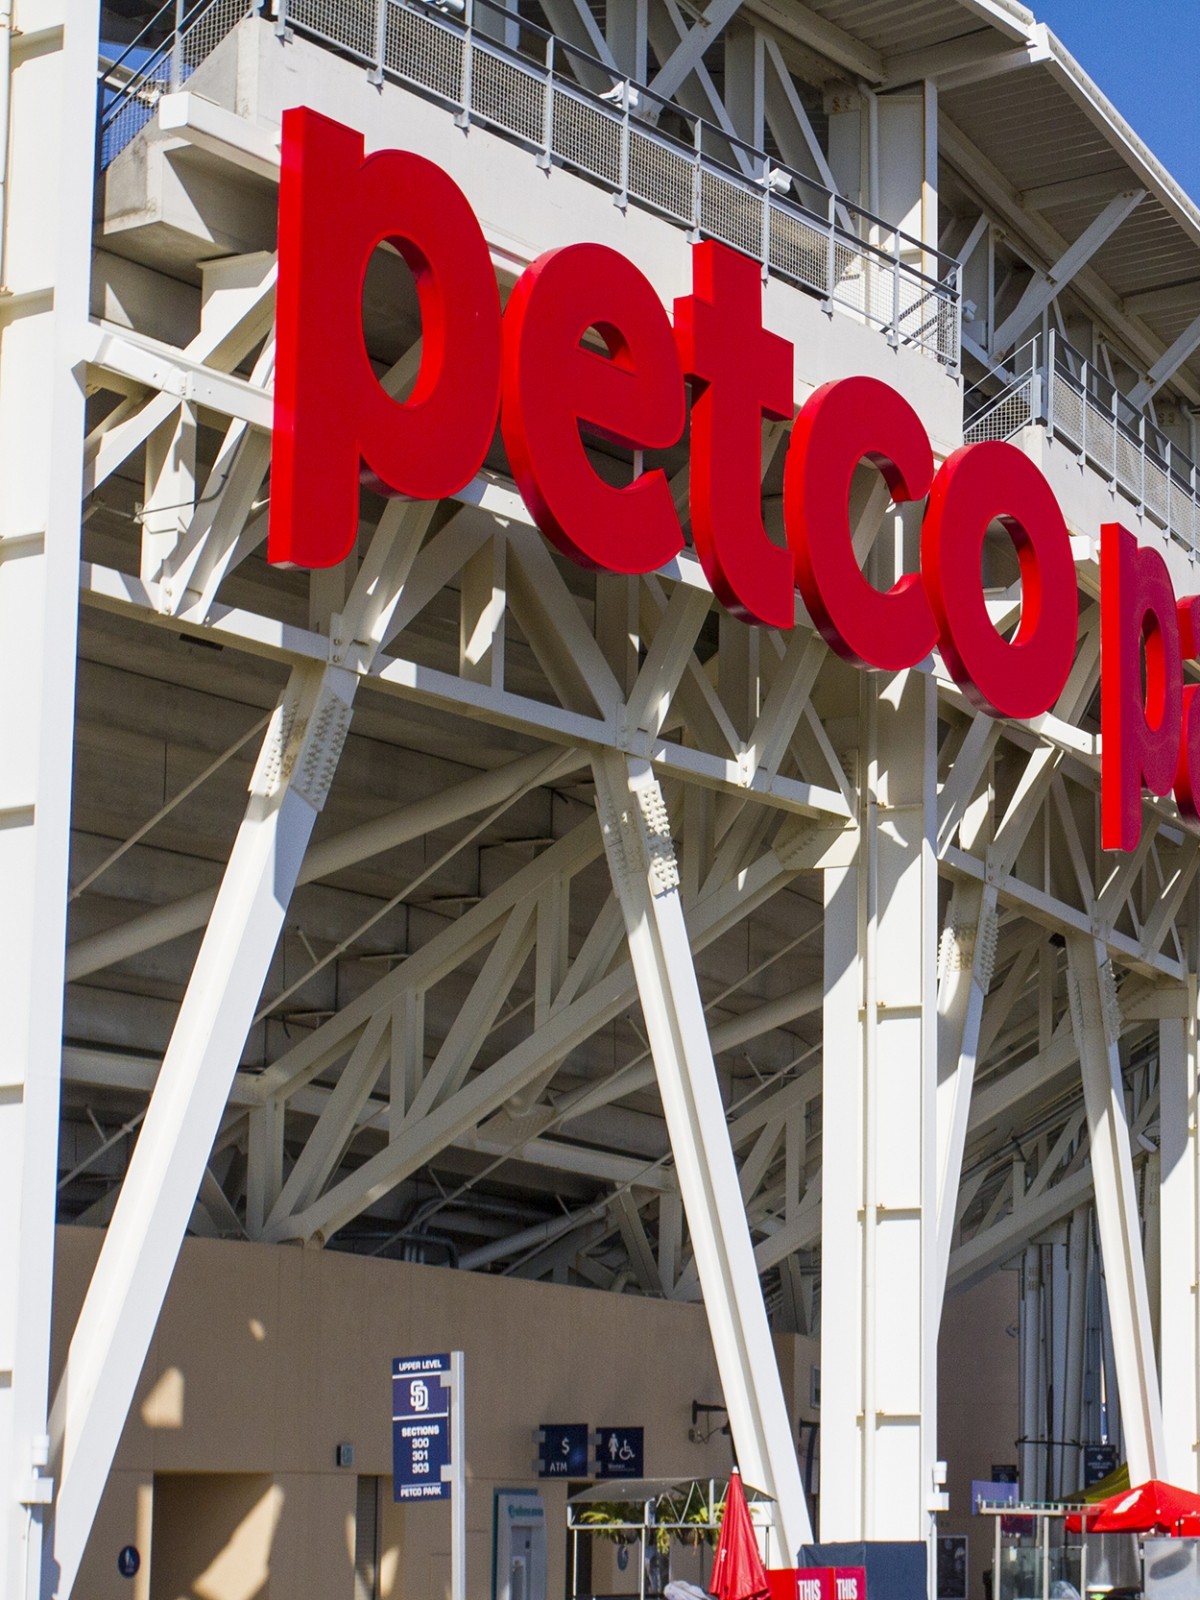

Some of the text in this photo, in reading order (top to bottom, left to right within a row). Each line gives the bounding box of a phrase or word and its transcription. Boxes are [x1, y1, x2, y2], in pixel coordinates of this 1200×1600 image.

[267, 105, 1077, 719] petco
[399, 1359, 442, 1372] UPPER LEVEL
[401, 1425, 440, 1437] SECTIONS
[412, 1438, 429, 1449] 300
[412, 1450, 429, 1461] 301
[412, 1462, 429, 1474] 303
[550, 1462, 568, 1473] ATM
[401, 1486, 442, 1498] PETCO PARK
[797, 1579, 821, 1600] THIS
[836, 1578, 858, 1600] THIS
